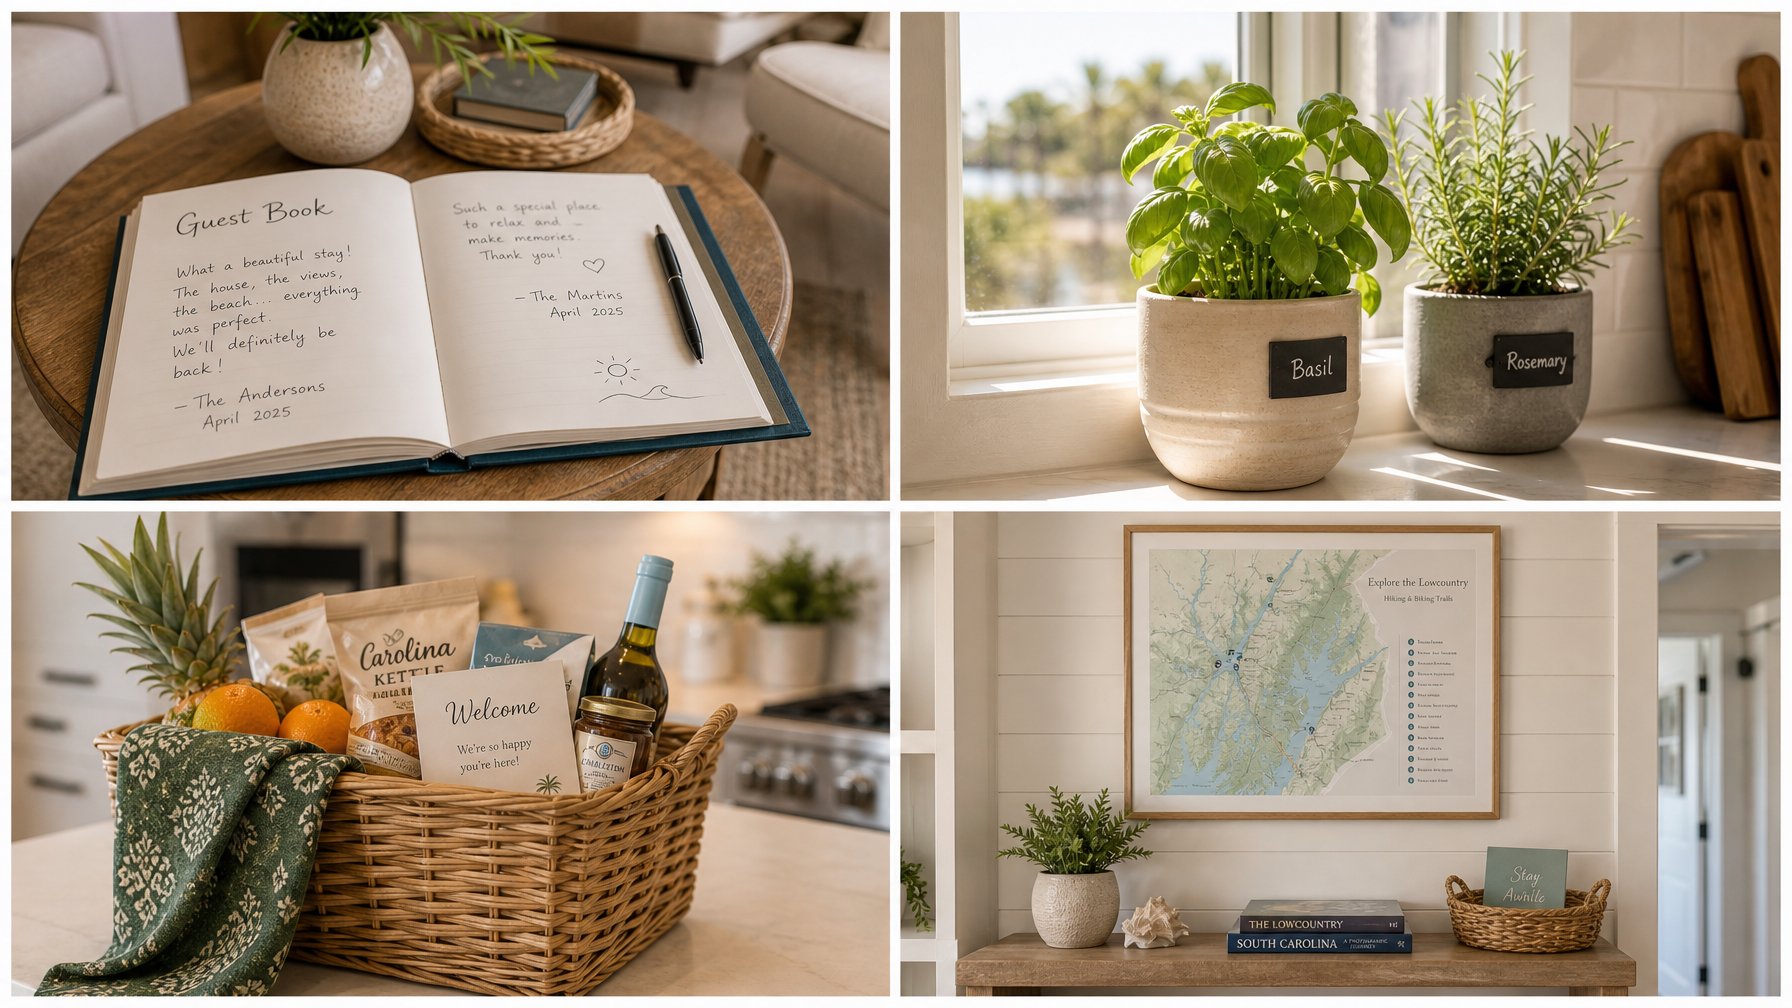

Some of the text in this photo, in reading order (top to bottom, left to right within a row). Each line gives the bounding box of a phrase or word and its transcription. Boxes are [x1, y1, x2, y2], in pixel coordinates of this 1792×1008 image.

[176, 197, 334, 238] Guest Book
[452, 200, 601, 216] Such a special place
[463, 219, 479, 230] to
[489, 217, 523, 228] relax
[534, 216, 561, 227] and
[468, 234, 504, 245] make
[176, 244, 351, 279] What a beautiful stay!
[479, 247, 564, 265] Thank you!
[172, 270, 343, 299] The house, the views,
[529, 290, 558, 302] The
[567, 289, 623, 301] Martins
[172, 305, 198, 318] the
[283, 284, 361, 304] everything
[172, 311, 273, 337] was perfect.
[550, 306, 624, 322] April 2025
[173, 326, 337, 358] We'll definitely be
[1290, 354, 1334, 380] Basil
[1506, 350, 1568, 375] Rosemary
[192, 392, 226, 410] The
[238, 382, 326, 404] Andersons
[202, 405, 291, 433] April 2025
[1368, 577, 1469, 590] Explore the Lowcountry
[1383, 594, 1407, 604] Hiking
[1413, 595, 1437, 604] Biking
[359, 635, 457, 673] Carolina
[445, 696, 540, 726] Welcome
[456, 739, 532, 755] We're so happy
[460, 755, 520, 776] you're here!
[1510, 865, 1542, 888] Stay
[1248, 920, 1344, 929] THE LOWCOUNTRY
[1236, 938, 1276, 949] SOUTH
[1279, 938, 1338, 949] CAROLINA
